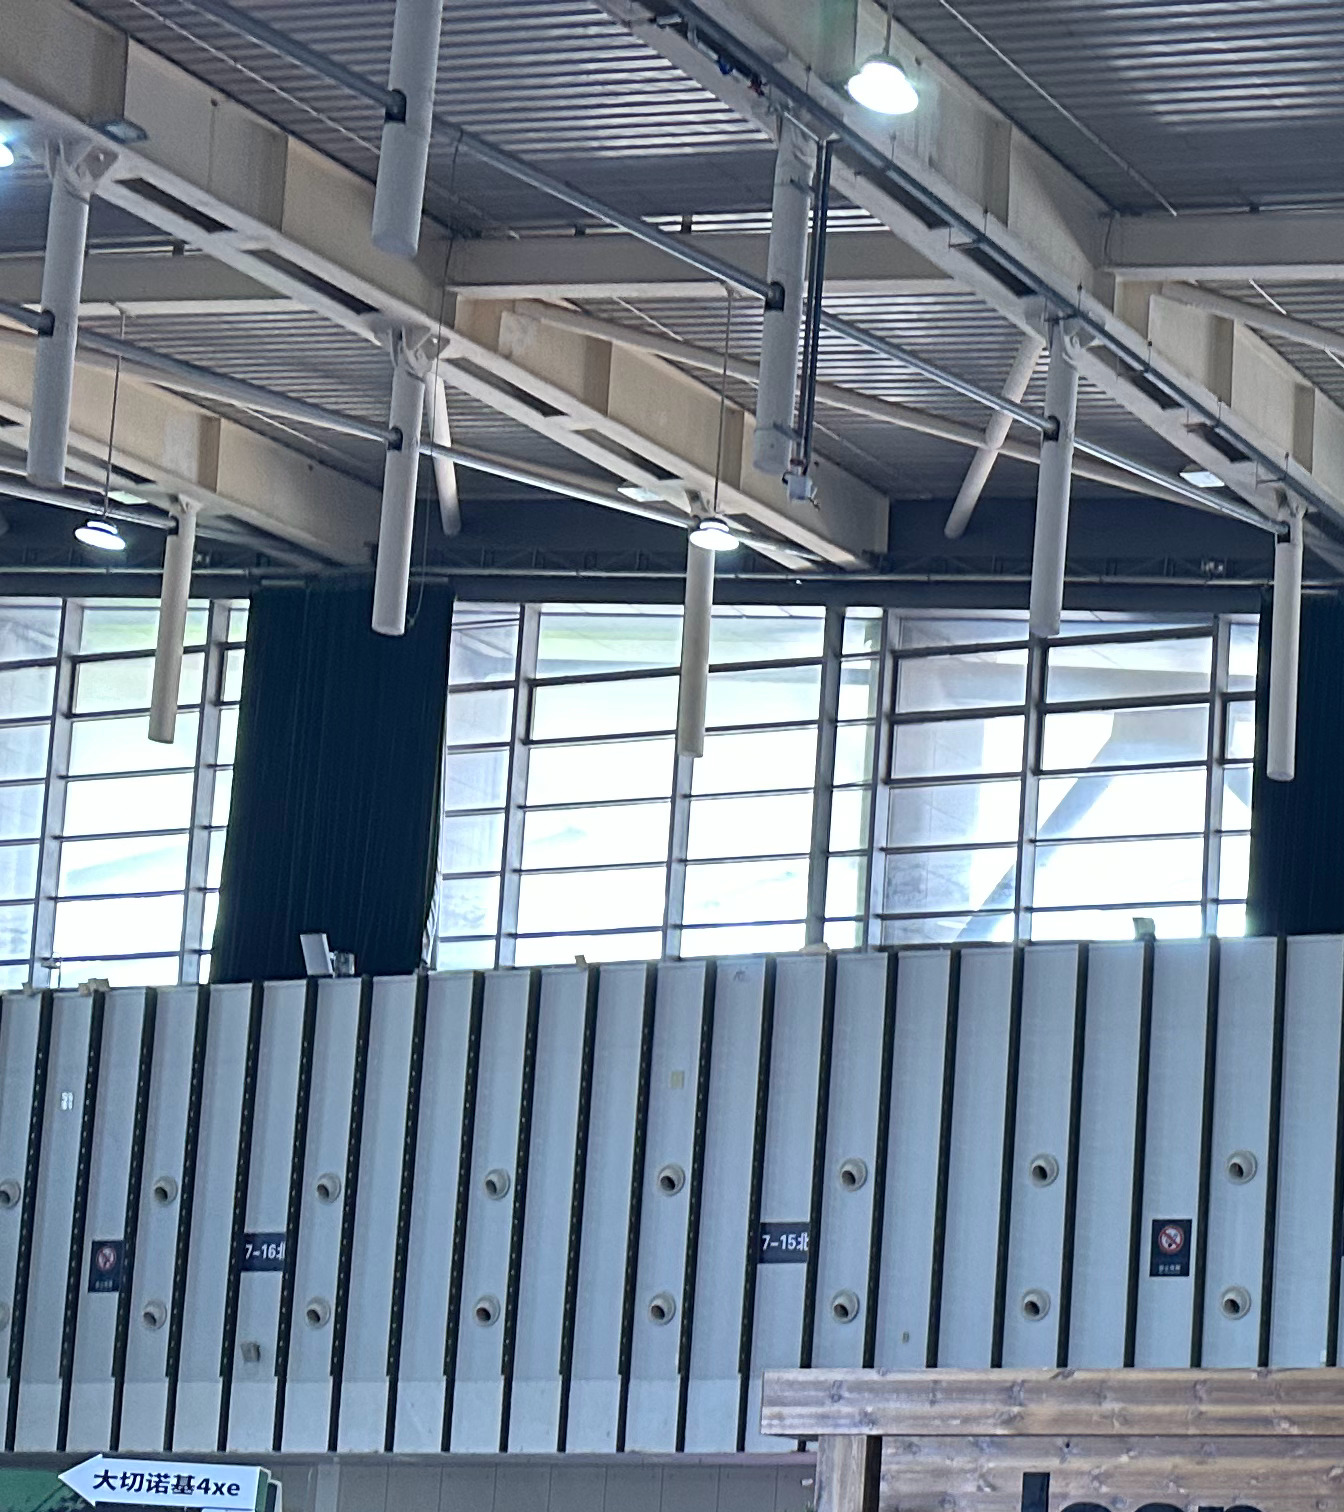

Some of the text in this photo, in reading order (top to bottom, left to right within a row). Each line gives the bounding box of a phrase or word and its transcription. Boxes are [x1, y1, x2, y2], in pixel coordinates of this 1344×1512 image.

[761, 1232, 810, 1252] 7-15北
[92, 1469, 241, 1497] 大切诺基4xe
